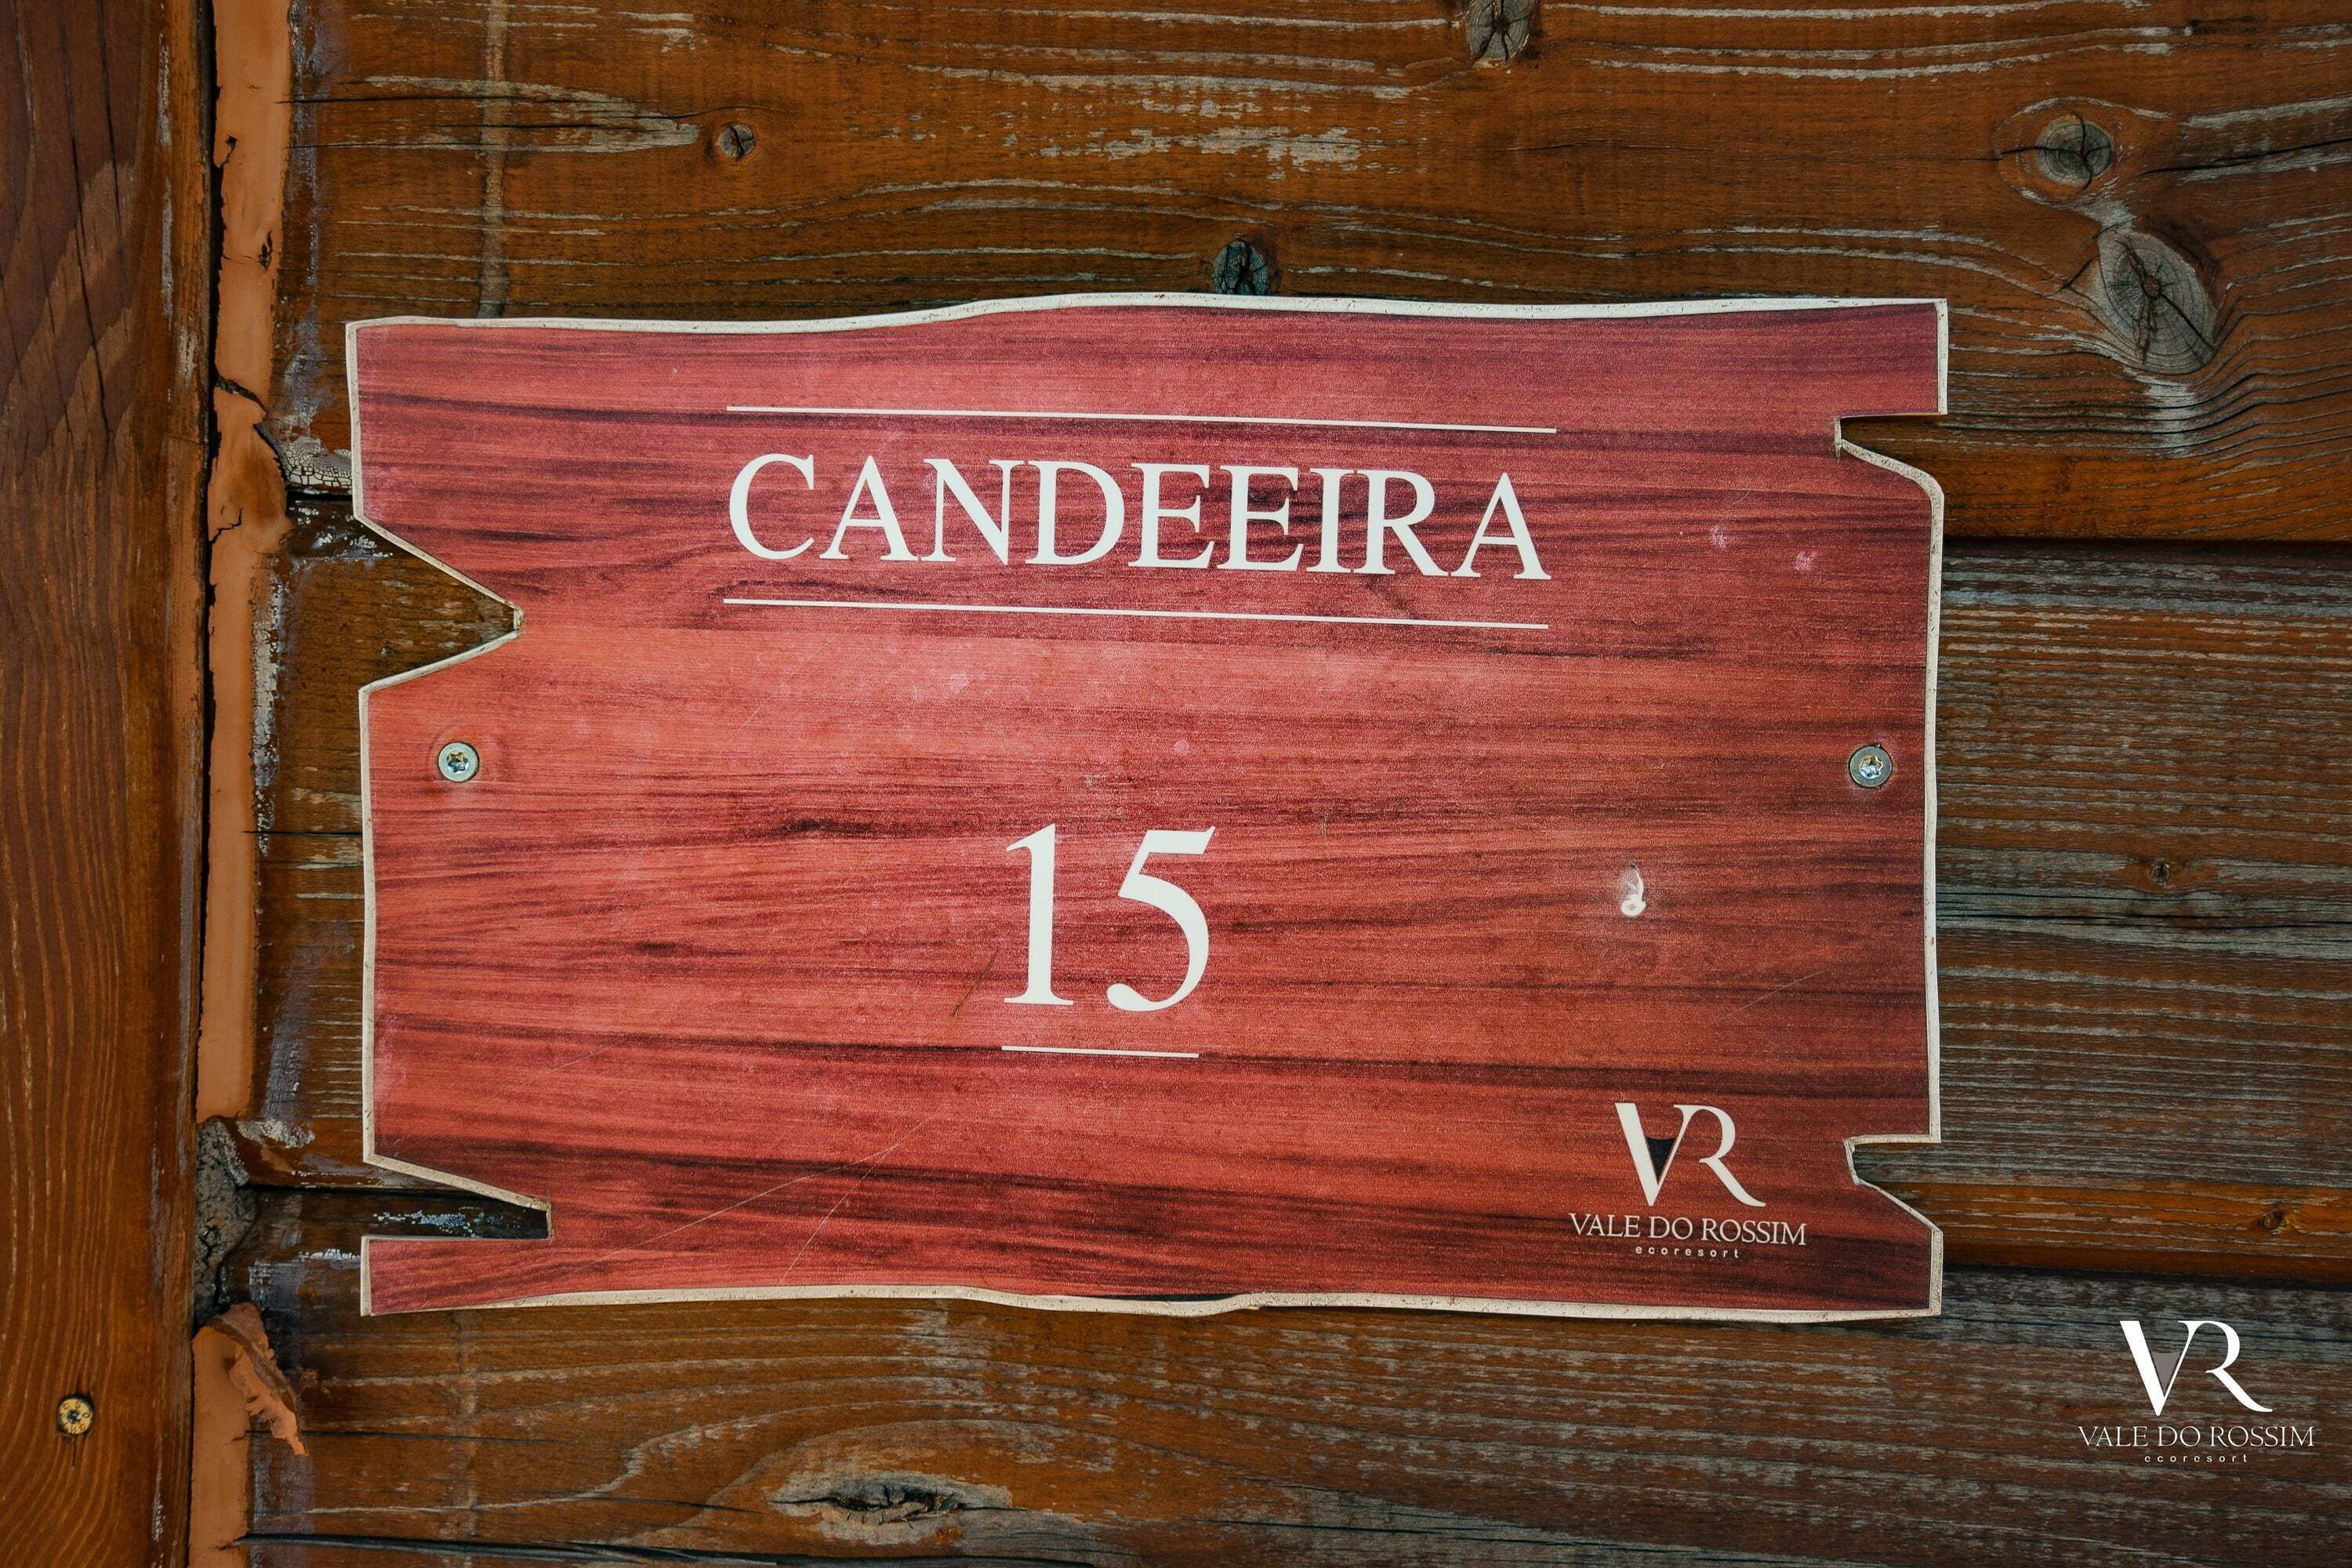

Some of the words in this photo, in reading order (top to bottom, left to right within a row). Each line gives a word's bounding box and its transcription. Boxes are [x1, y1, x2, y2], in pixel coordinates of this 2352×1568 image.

[728, 452, 1552, 581] CANDEEIRA
[1003, 822, 1217, 1013] 15
[1613, 1102, 1766, 1208] VR
[1568, 1212, 1642, 1238] VALE
[1647, 1215, 1694, 1240] DO
[1700, 1217, 1808, 1247] ROSSIM
[1635, 1247, 1740, 1259] ecoresort
